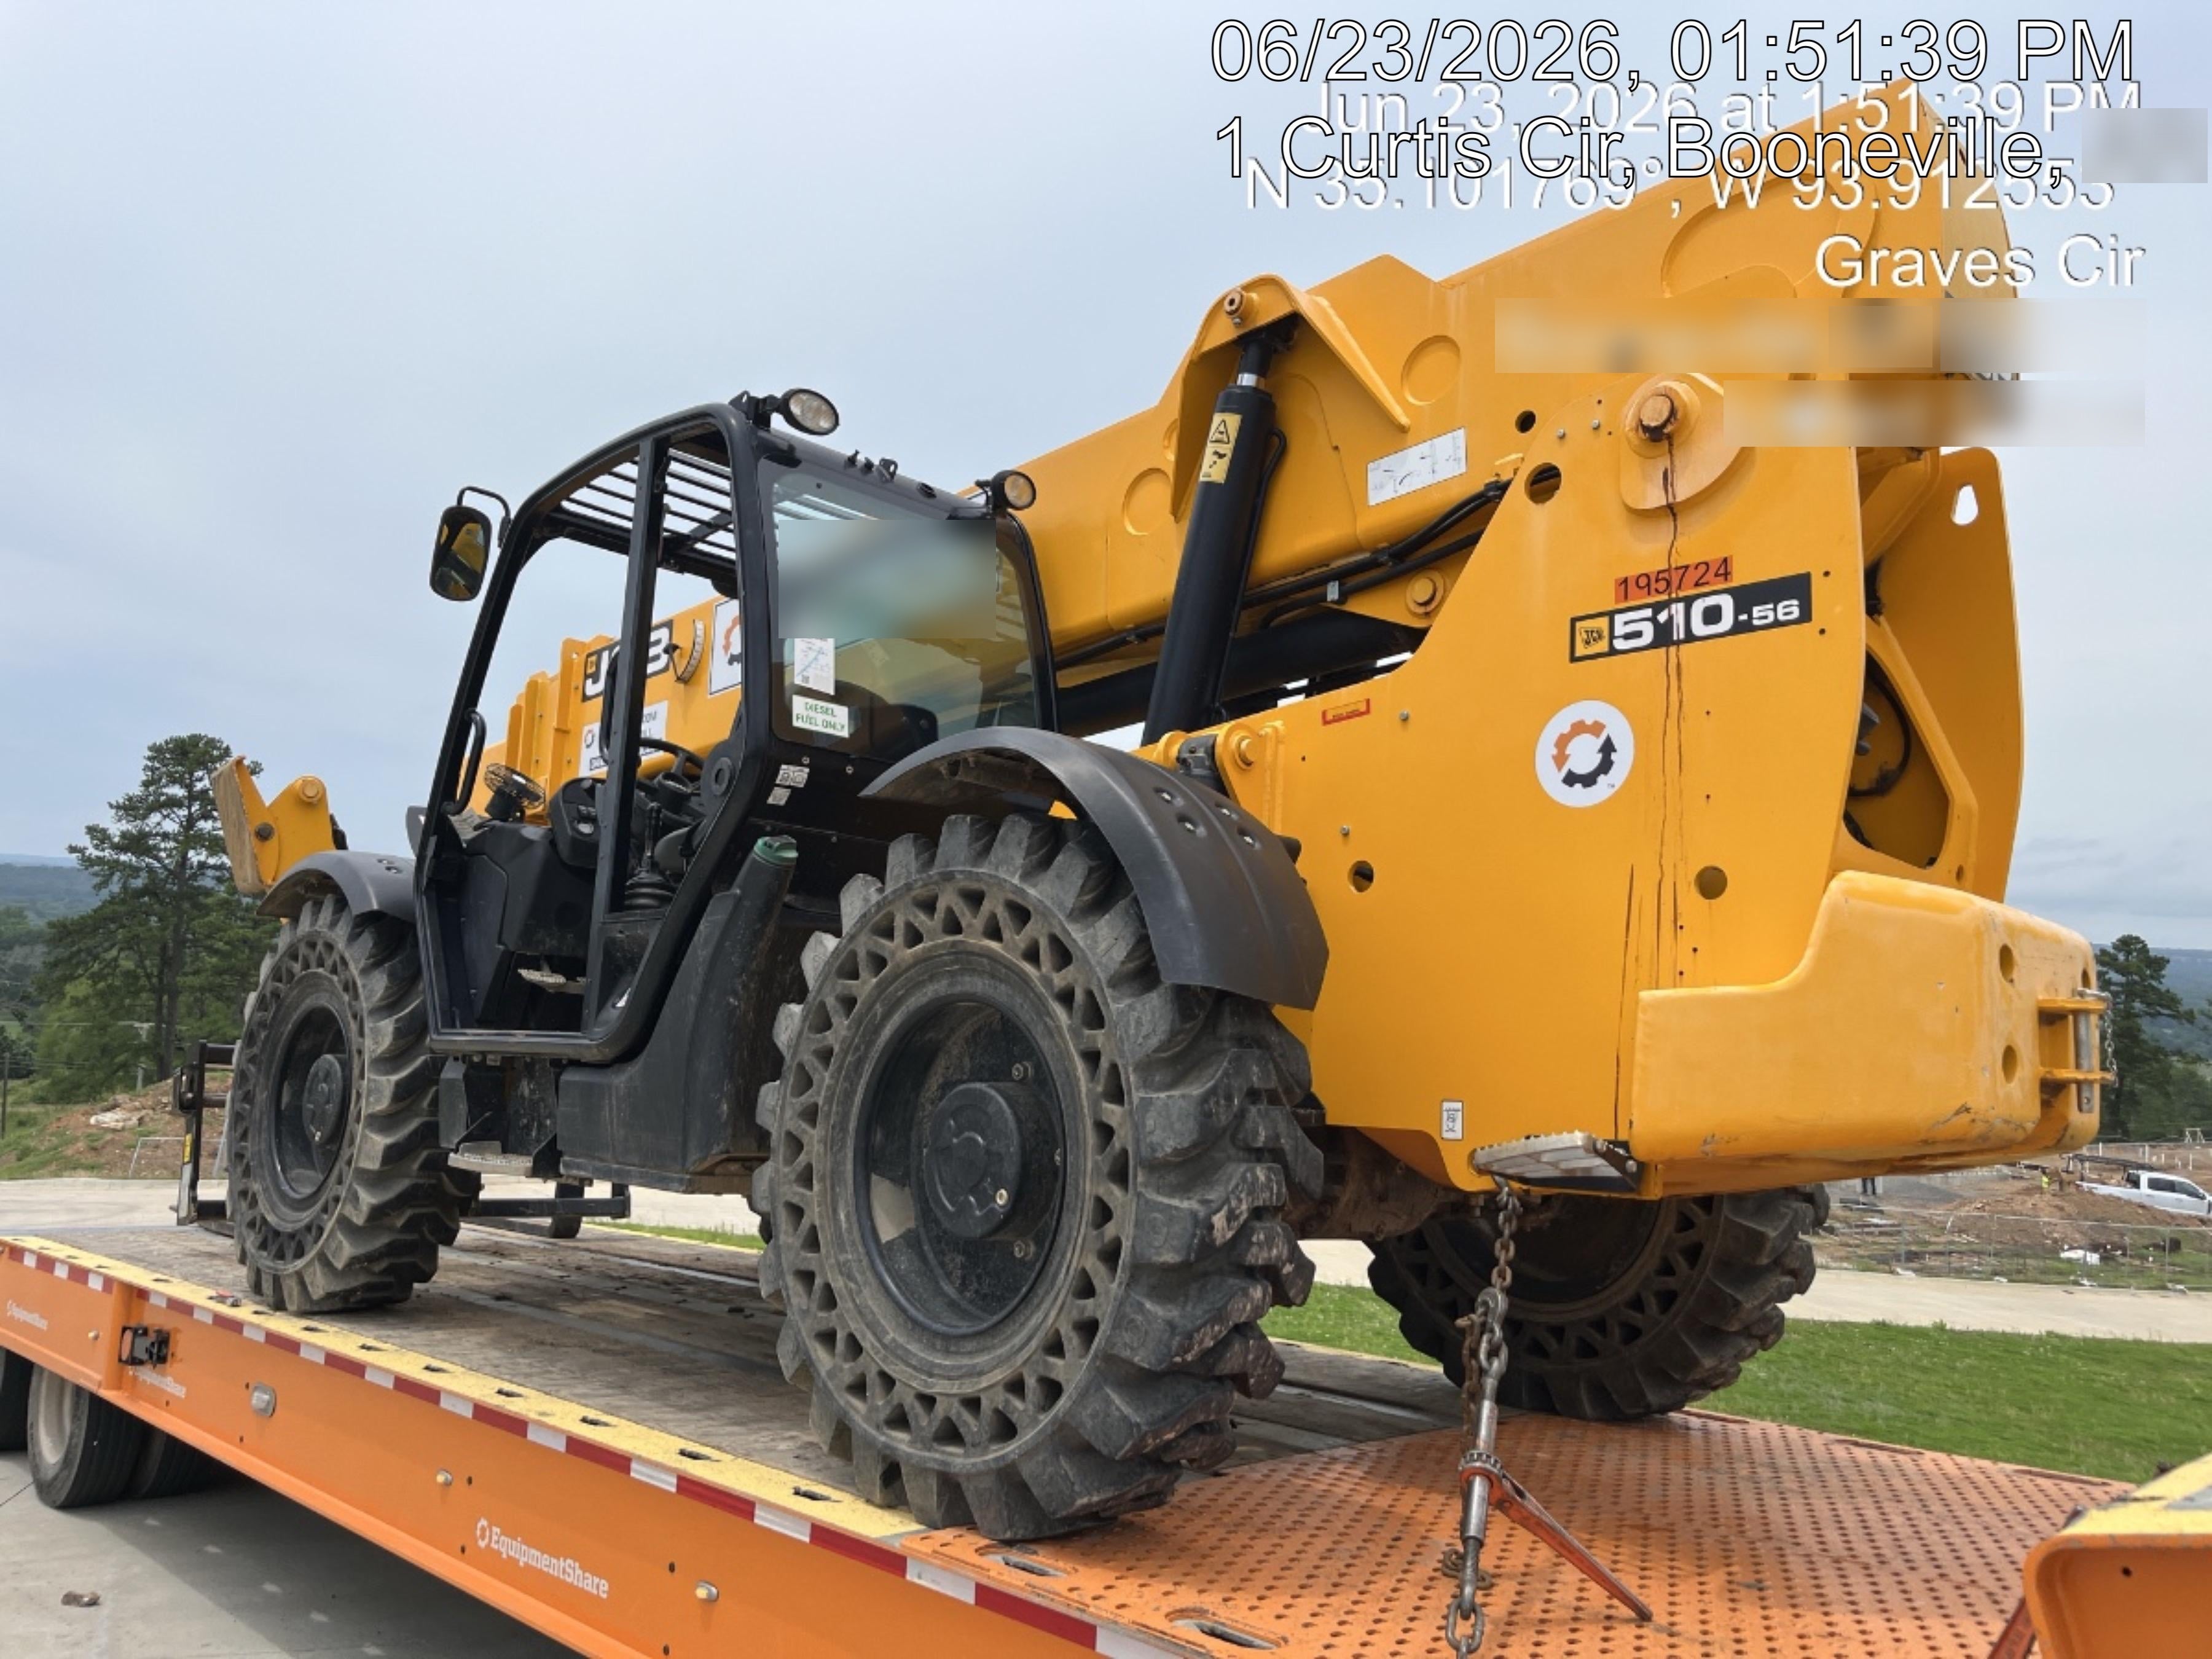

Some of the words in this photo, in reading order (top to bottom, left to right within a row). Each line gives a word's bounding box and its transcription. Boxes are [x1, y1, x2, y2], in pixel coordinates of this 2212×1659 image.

[1618, 557, 1731, 600] 195724
[584, 626, 671, 697] JB
[796, 713, 819, 727] FUEL
[822, 720, 845, 732] ONLY
[804, 702, 837, 718] DIESEL
[490, 1525, 610, 1599] EquipmentShare
